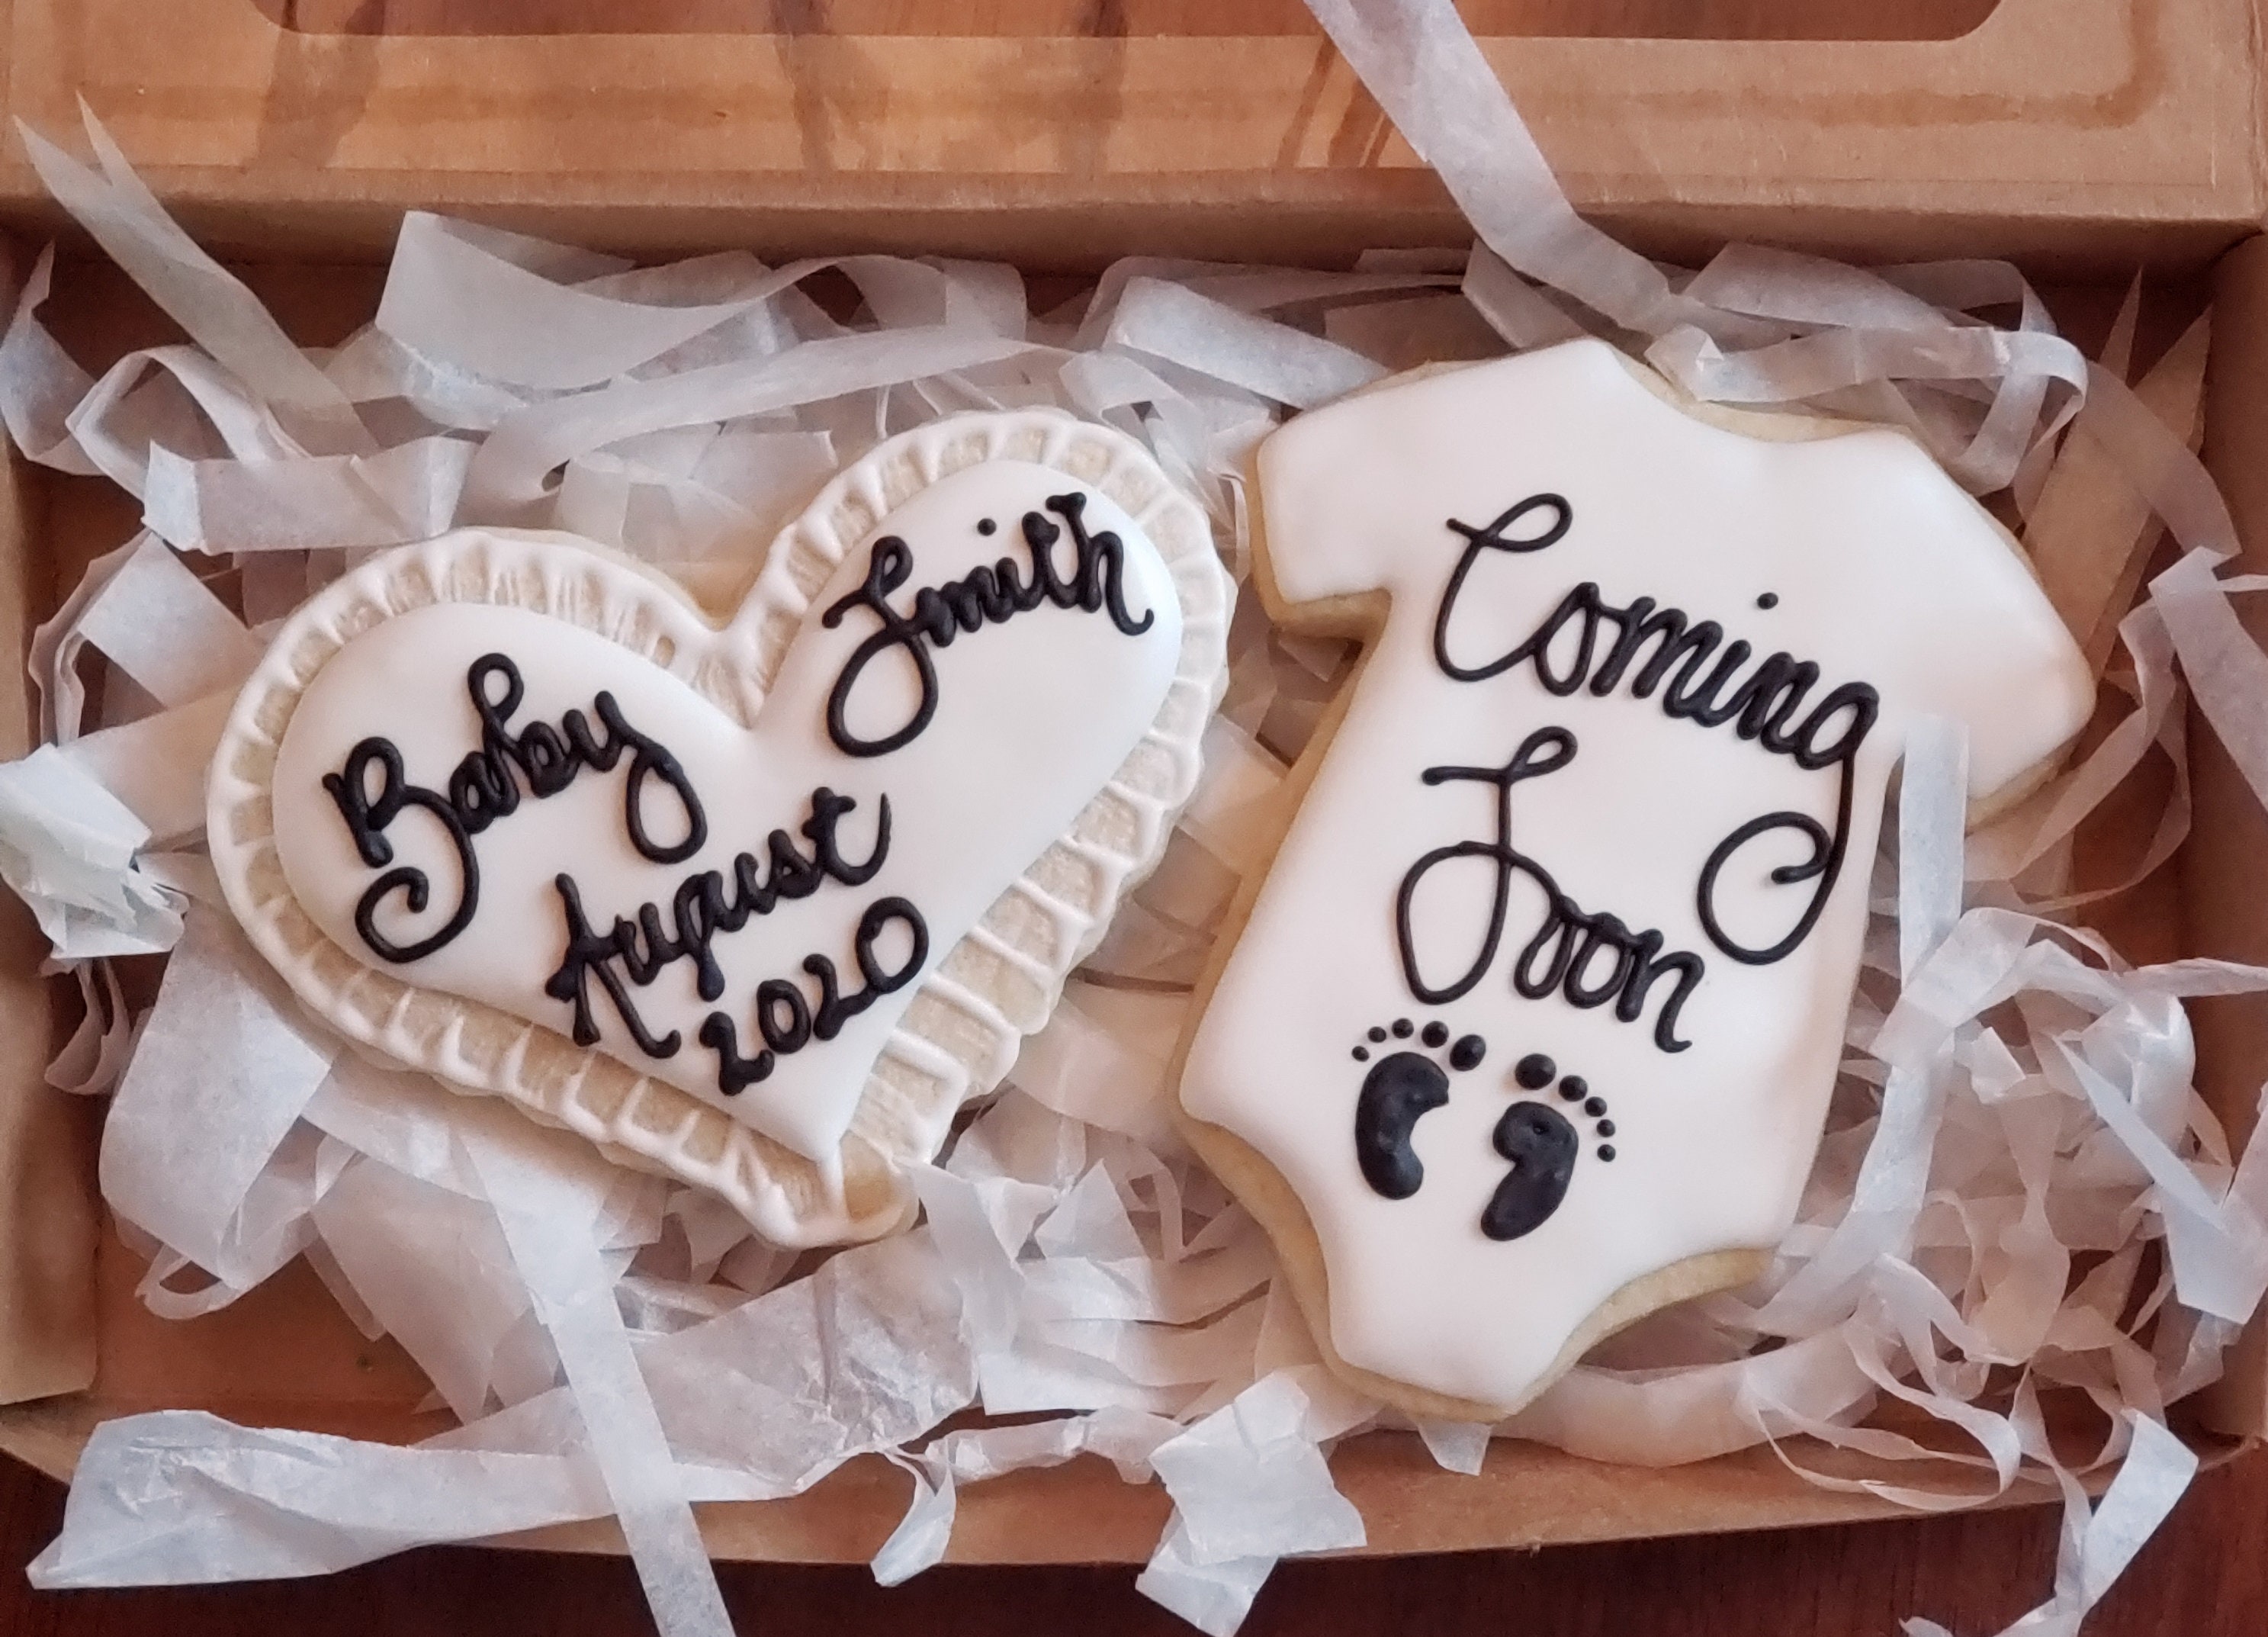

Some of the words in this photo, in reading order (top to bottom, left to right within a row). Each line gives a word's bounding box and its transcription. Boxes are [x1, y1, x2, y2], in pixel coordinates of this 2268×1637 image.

[322, 652, 708, 966] Baby
[821, 491, 1155, 758] Smith
[1396, 725, 1705, 1053] Soon
[1434, 493, 1881, 966] Coming
[544, 786, 891, 1060] August
[698, 896, 929, 1097] 2020
